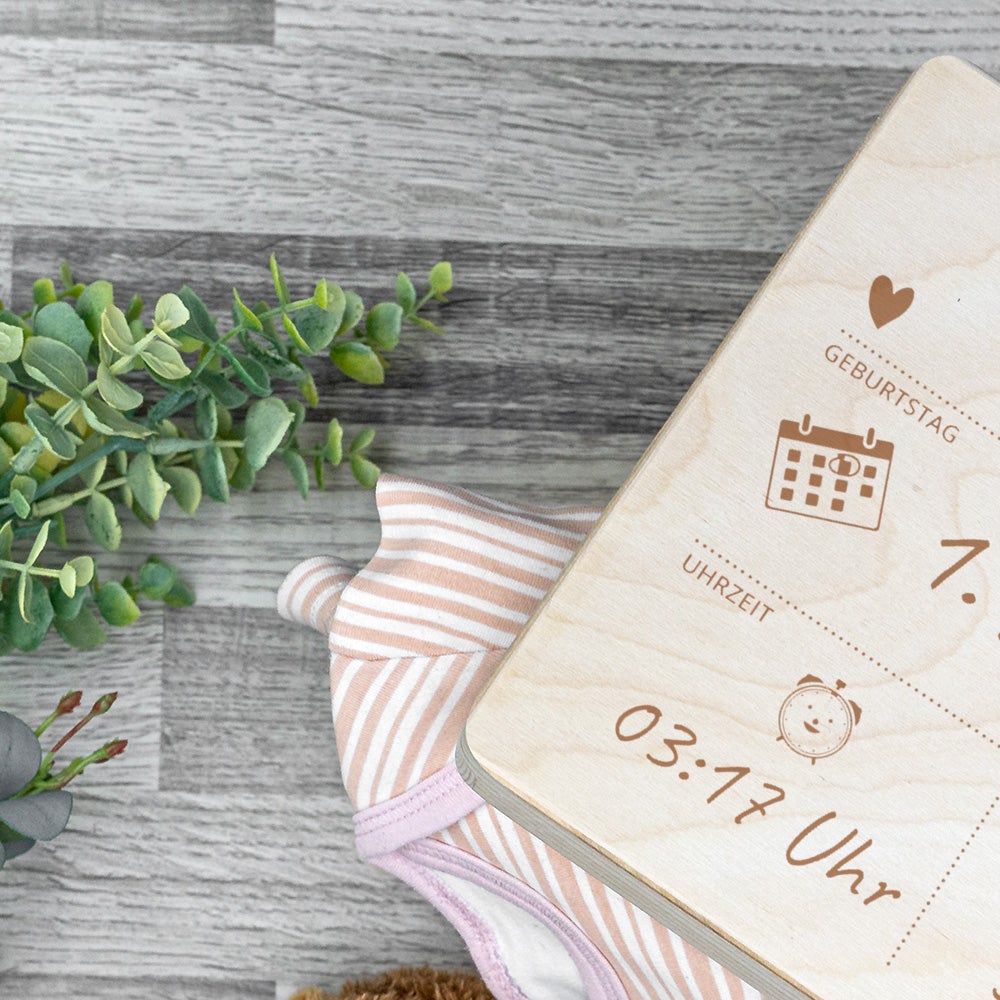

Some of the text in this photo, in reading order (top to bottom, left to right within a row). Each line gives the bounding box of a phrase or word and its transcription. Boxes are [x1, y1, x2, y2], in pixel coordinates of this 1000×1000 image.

[824, 343, 960, 444] GEBURTSTAG
[682, 553, 775, 623] UHRZEIT
[930, 538, 990, 605] 1.
[614, 704, 901, 905] 03:17 Uhr
